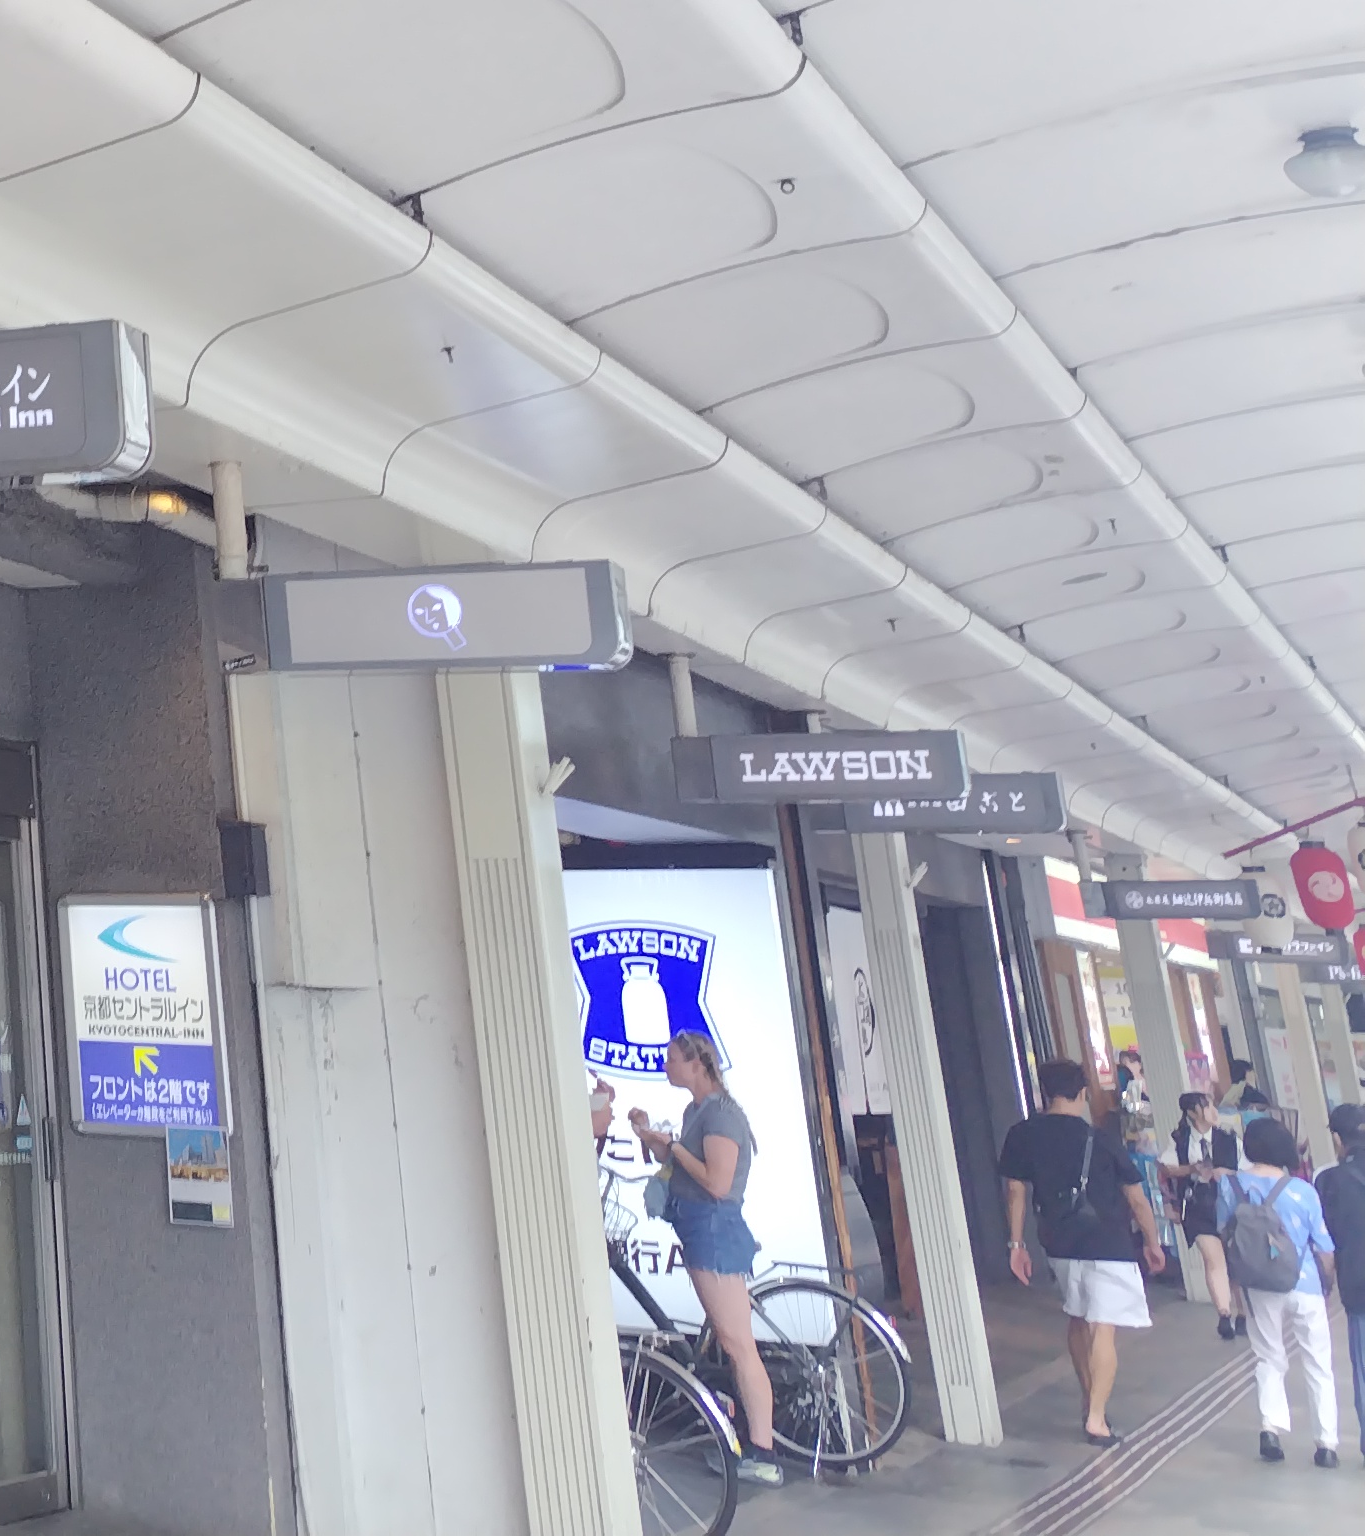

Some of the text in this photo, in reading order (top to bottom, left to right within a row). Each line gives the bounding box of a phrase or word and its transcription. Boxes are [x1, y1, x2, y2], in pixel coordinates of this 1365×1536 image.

[9, 406, 54, 430] Inn
[739, 749, 933, 782] LAWSON
[574, 930, 701, 962] LAWSON
[105, 967, 177, 993] HOTEL
[83, 995, 204, 1023] 京都セントラルイン
[588, 1037, 668, 1070] STAT
[89, 1075, 210, 1107] フロントは2階です
